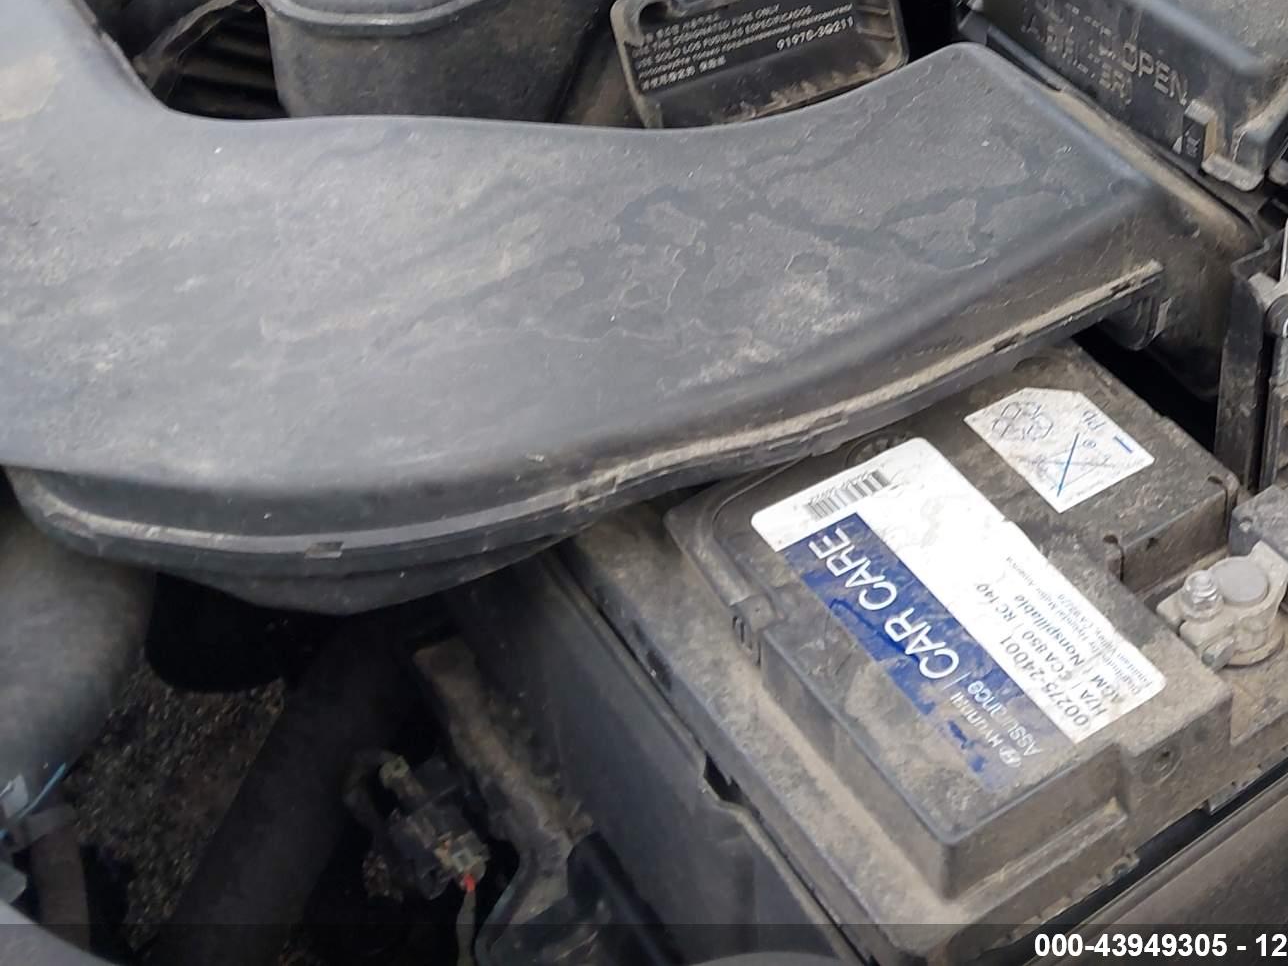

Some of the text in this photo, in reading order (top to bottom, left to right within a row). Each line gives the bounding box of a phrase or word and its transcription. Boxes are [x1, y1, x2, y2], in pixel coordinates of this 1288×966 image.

[755, 3, 780, 18] ONLY
[683, 40, 701, 54] LOS
[1121, 40, 1188, 106] OPEN
[808, 527, 898, 612] CARE
[884, 607, 960, 680] CAR
[995, 602, 1017, 623] RC
[1013, 593, 1085, 667] Nonspillable
